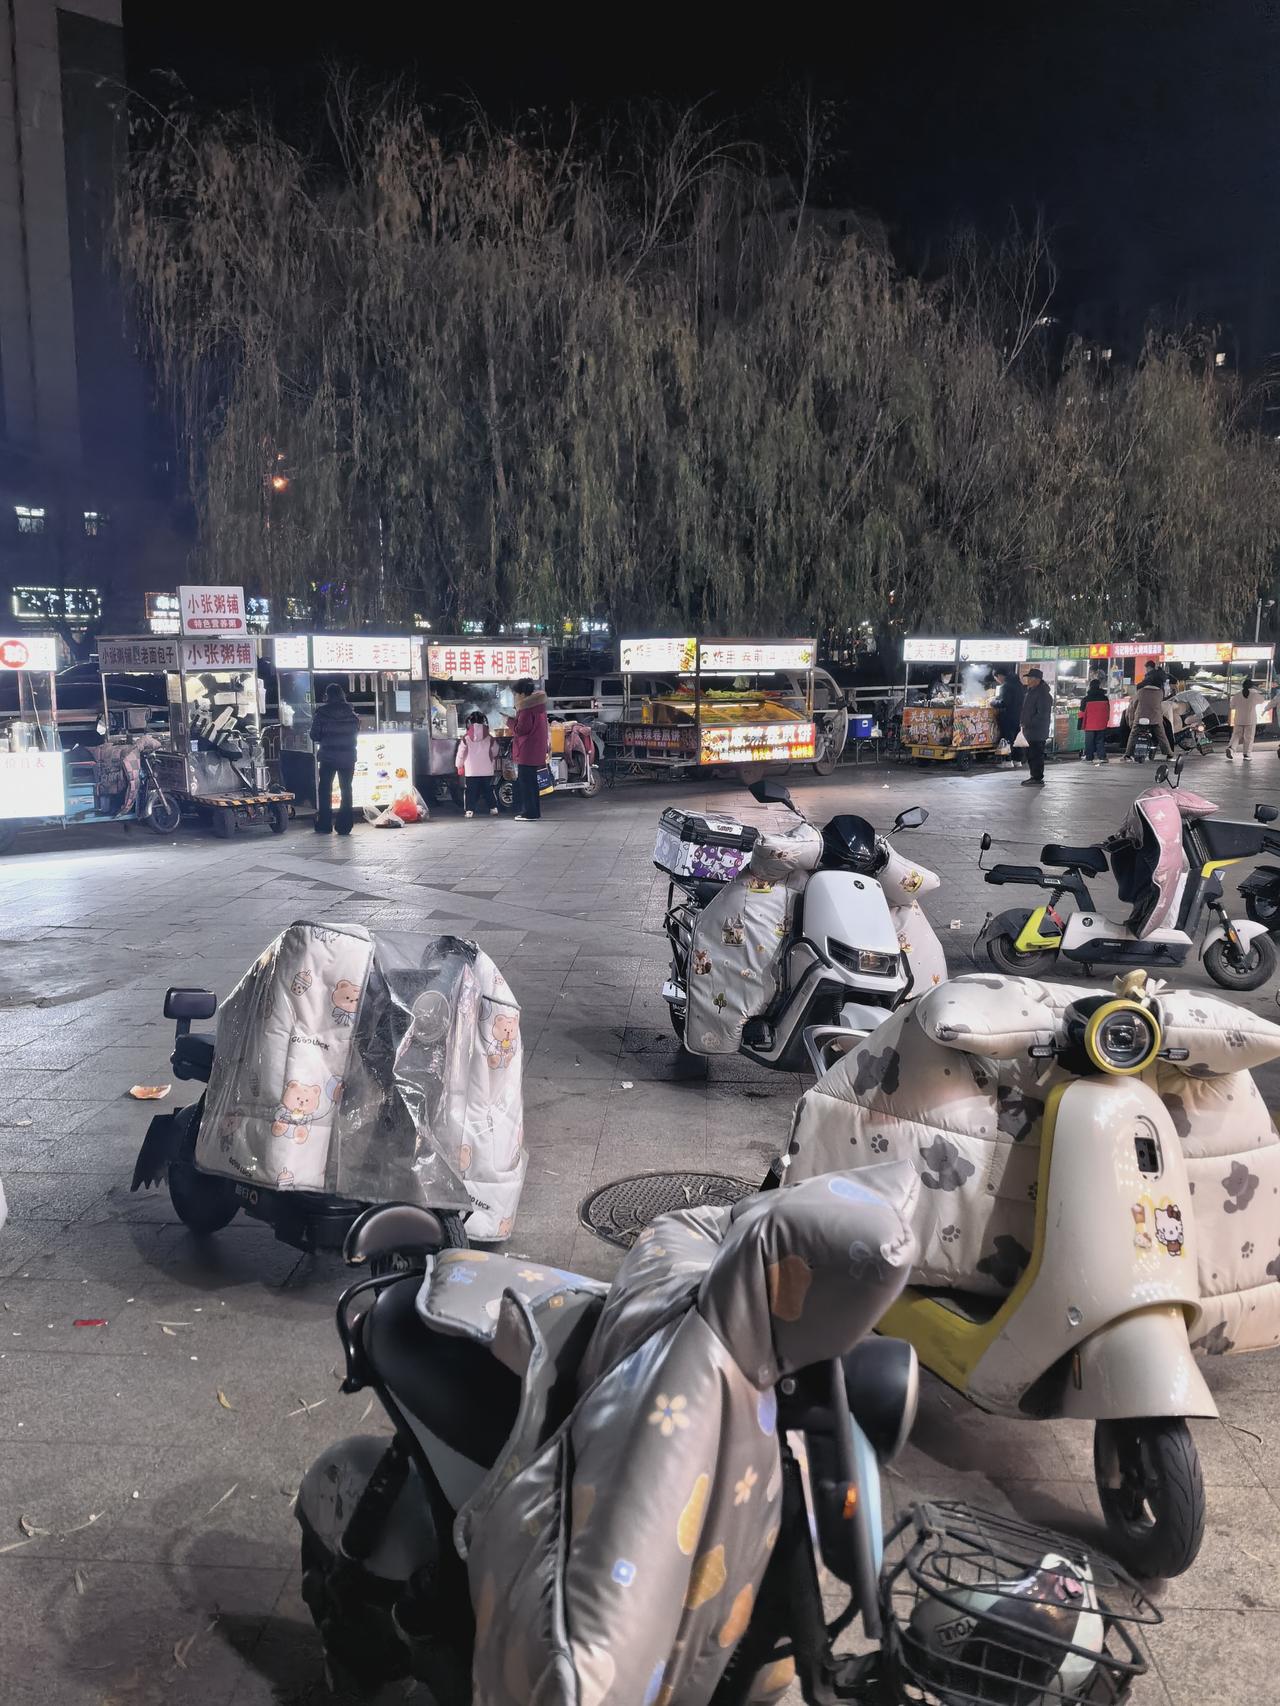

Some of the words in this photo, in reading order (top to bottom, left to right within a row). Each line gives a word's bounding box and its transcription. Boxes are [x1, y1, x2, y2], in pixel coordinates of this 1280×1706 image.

[187, 593, 239, 614] 小张粥铺
[188, 643, 252, 665] 小张粥铺
[444, 648, 486, 675] 串串香
[491, 649, 531, 674] 相思面
[475, 1199, 491, 1210] LUCK
